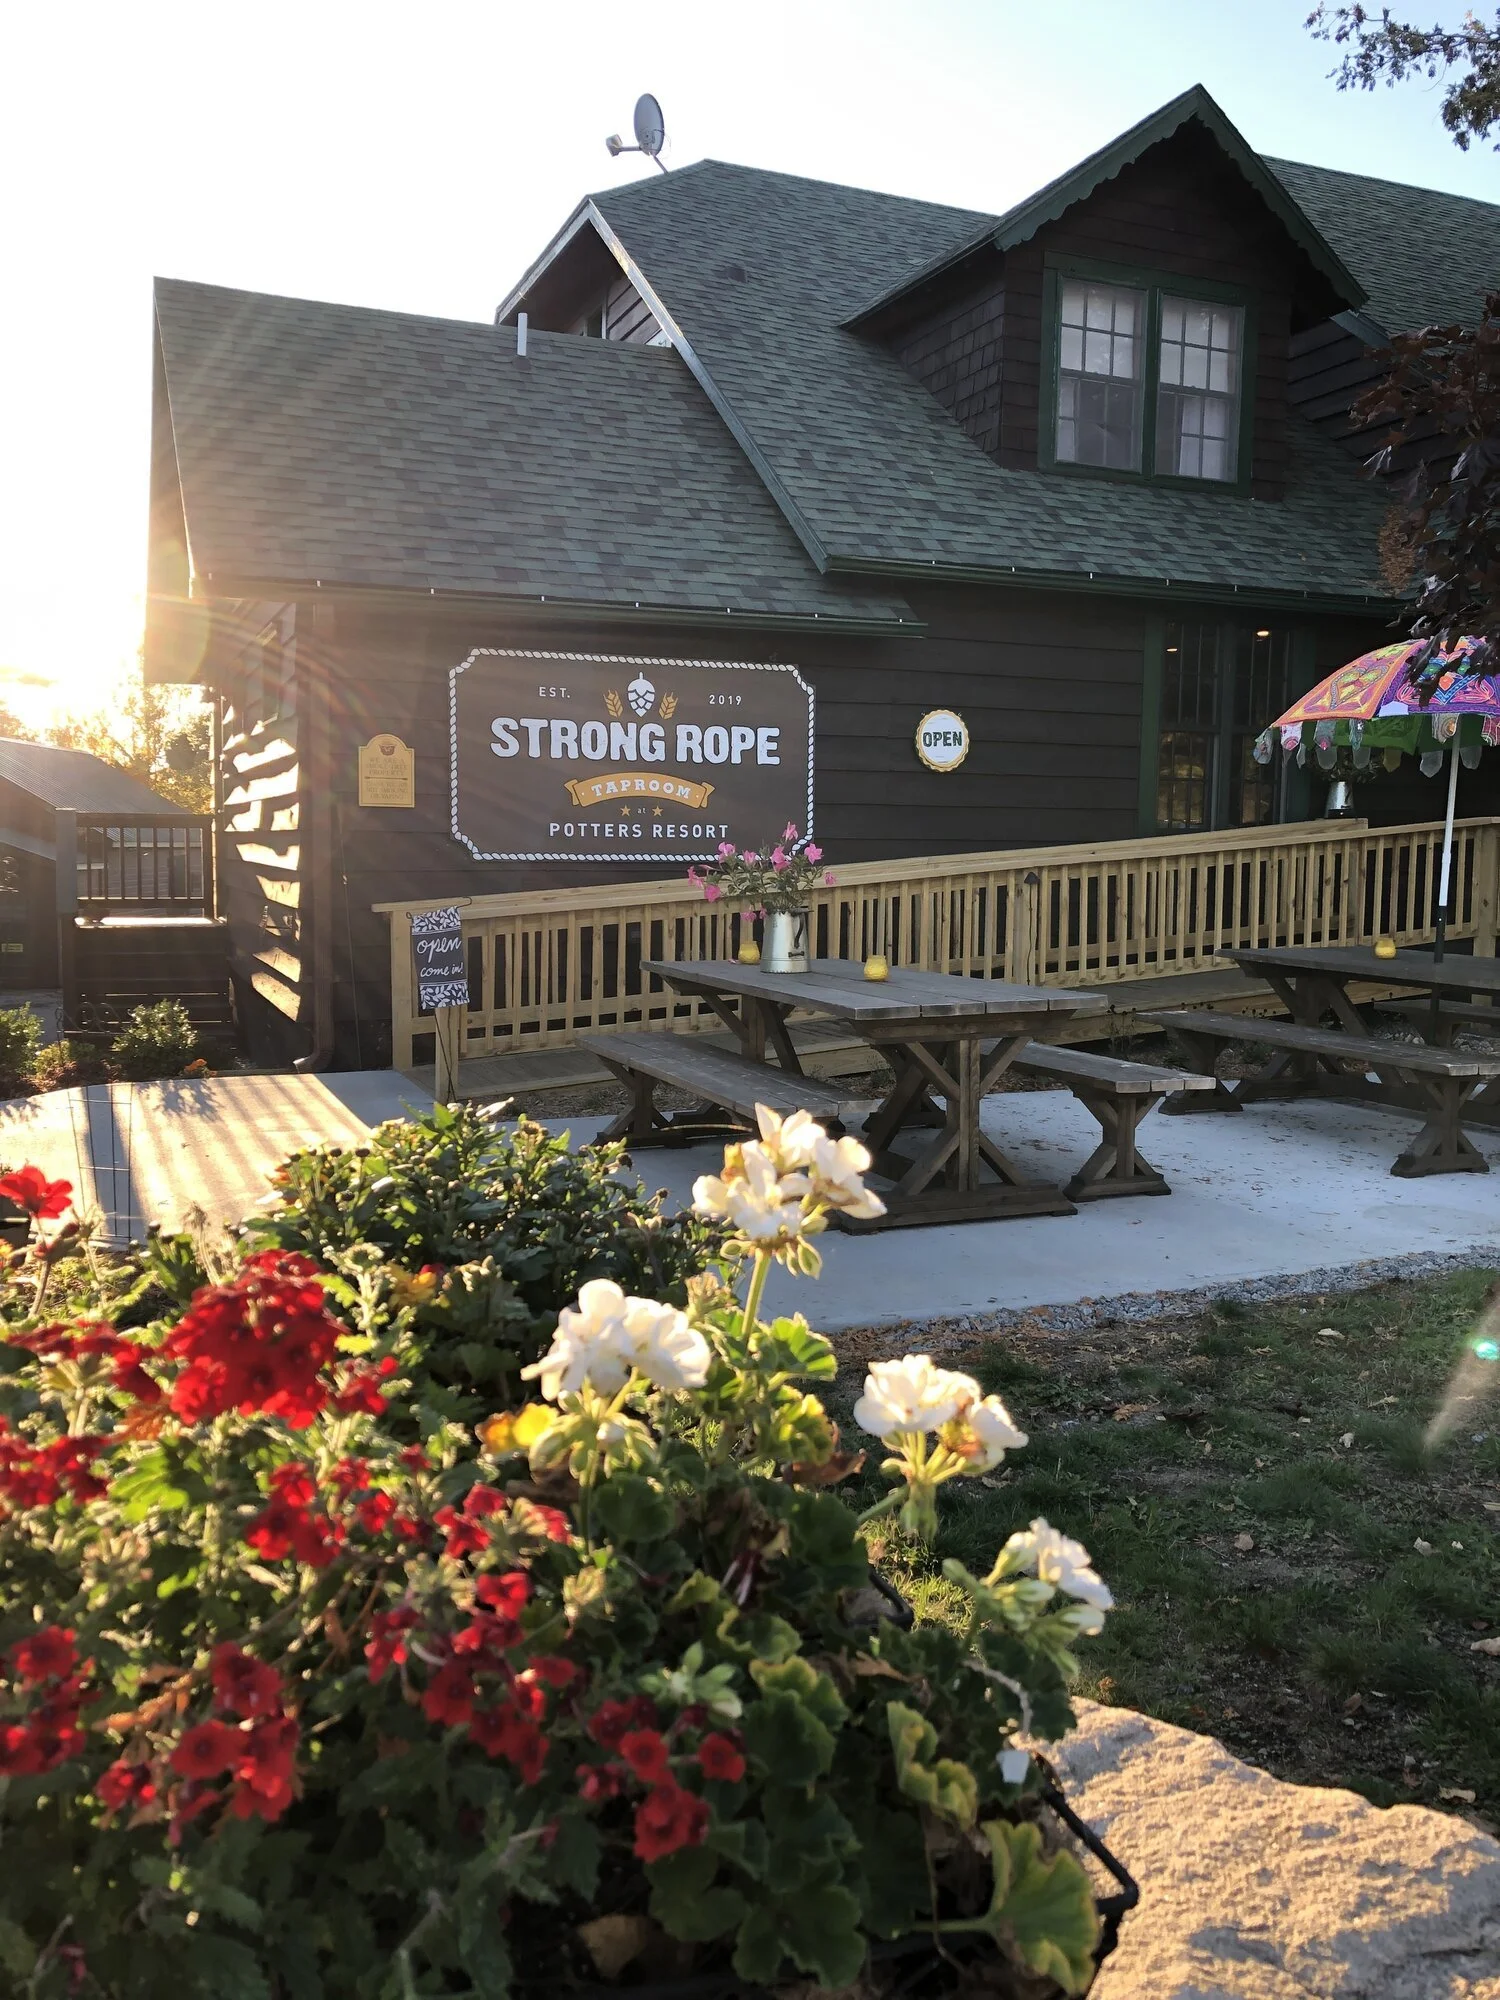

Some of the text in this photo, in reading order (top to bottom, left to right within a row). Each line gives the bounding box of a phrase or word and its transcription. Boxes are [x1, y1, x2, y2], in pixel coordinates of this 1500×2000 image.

[539, 686, 571, 699] EST.
[709, 694, 742, 706] 2019
[490, 717, 781, 765] STRONG ROPE
[922, 731, 963, 747] OPEN
[591, 779, 691, 799] TAPROOM
[549, 823, 728, 838] POTTERS RESORT
[420, 962, 464, 978] come in!
